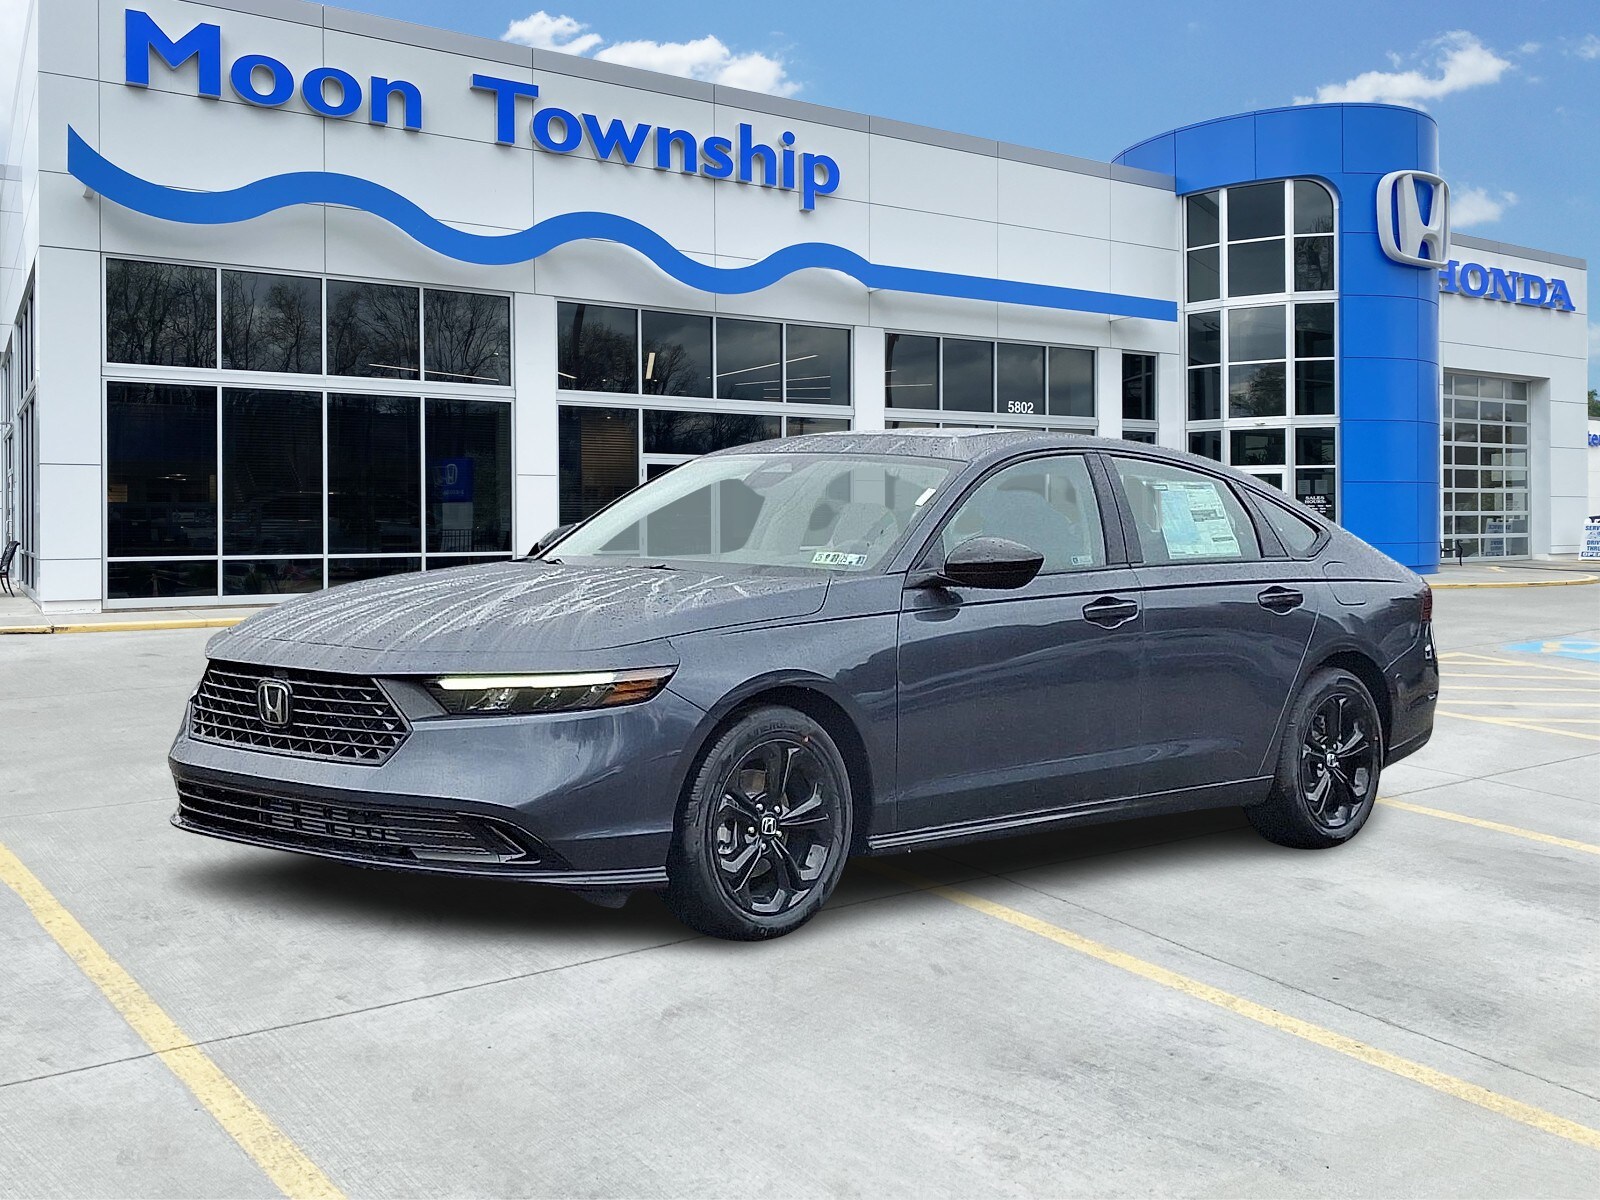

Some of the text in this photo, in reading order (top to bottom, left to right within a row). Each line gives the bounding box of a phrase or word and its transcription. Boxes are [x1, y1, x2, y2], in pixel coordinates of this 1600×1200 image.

[125, 9, 840, 212] Moon Township
[1007, 400, 1034, 414] 5802
